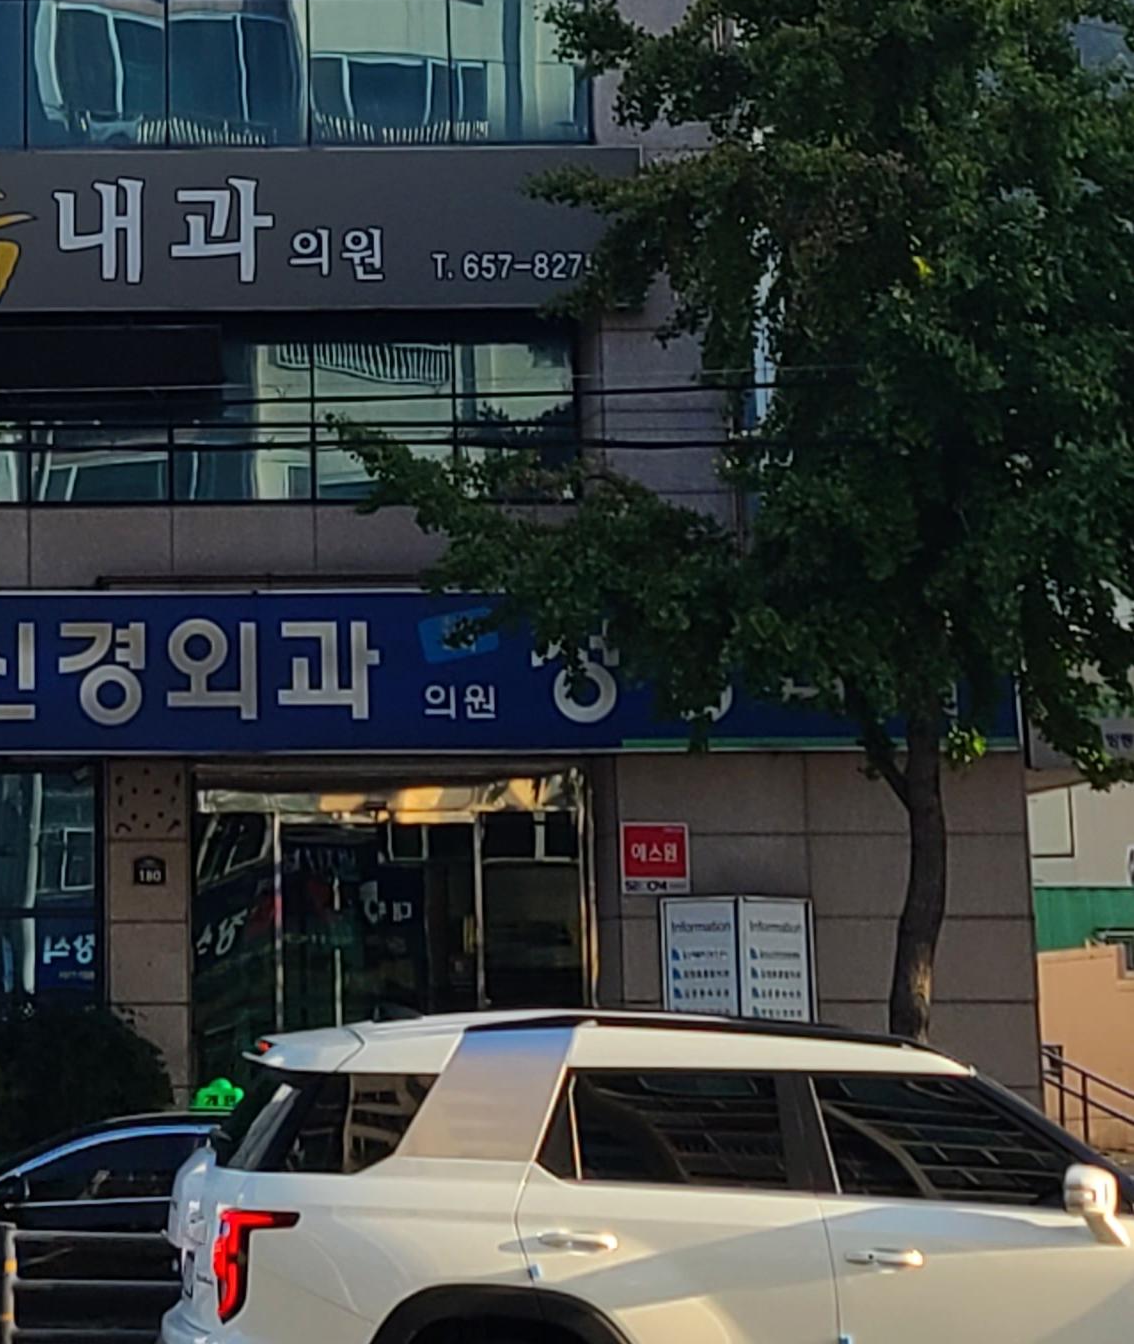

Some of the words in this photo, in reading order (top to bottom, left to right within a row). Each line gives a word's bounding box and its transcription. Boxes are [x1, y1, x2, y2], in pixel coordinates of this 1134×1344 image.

[423, 682, 498, 720] 의원
[630, 842, 678, 863] 에스원
[139, 869, 162, 882] 180
[670, 920, 732, 934] Information
[749, 921, 802, 934] Information
